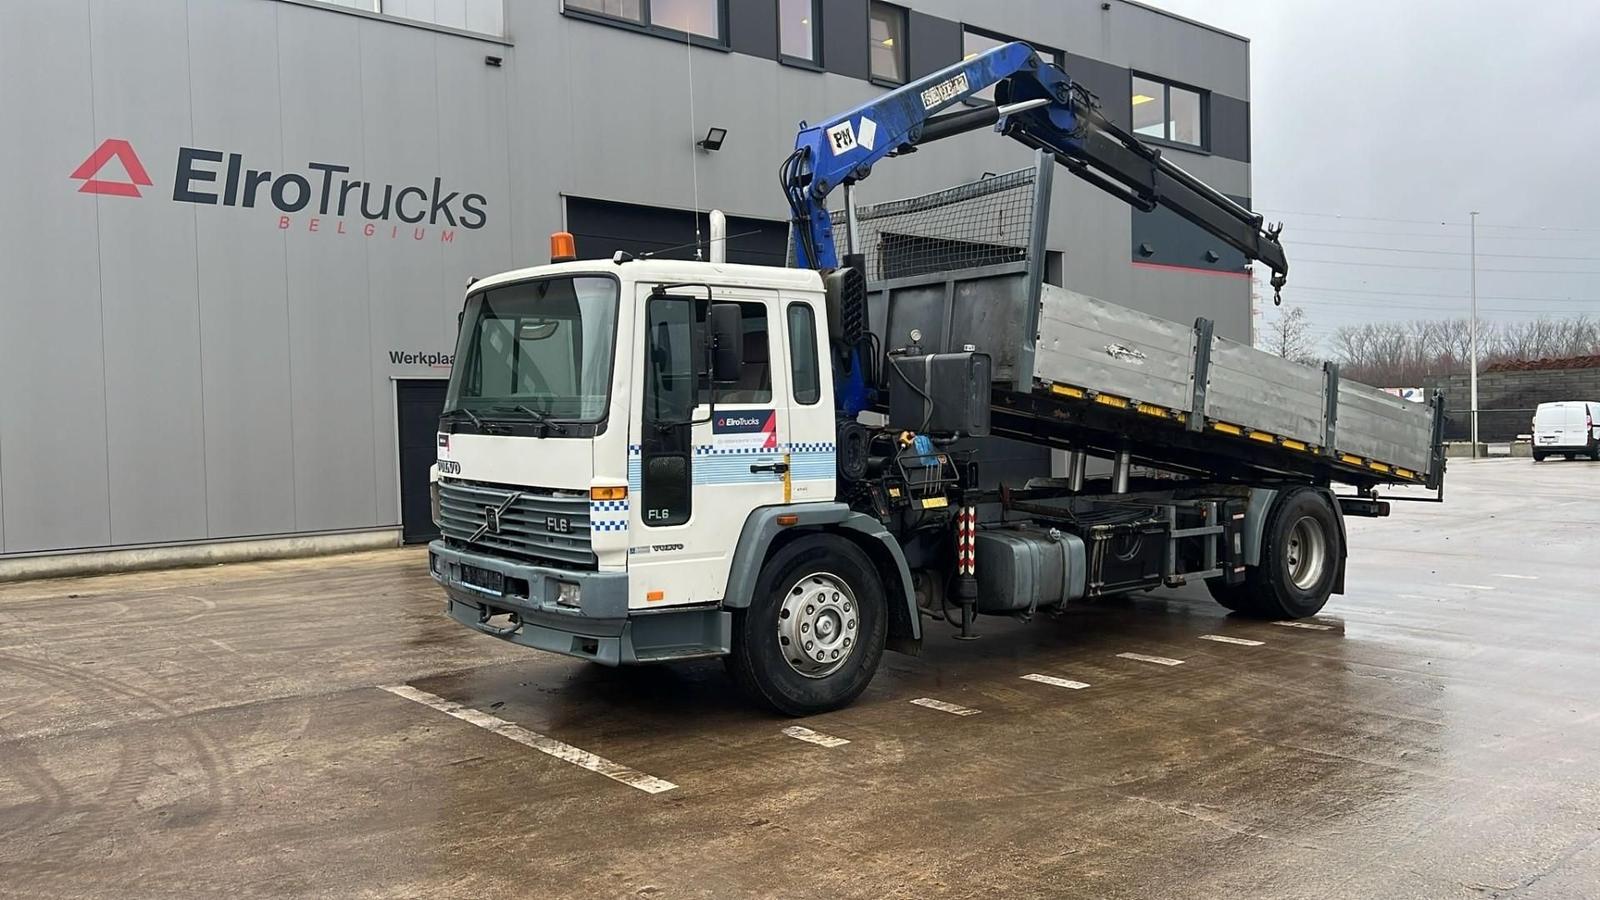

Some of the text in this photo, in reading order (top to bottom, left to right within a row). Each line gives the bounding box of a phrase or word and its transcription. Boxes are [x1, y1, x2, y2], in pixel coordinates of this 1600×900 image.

[833, 128, 853, 148] PM
[172, 147, 487, 229] ElroTrucks
[278, 215, 454, 242] BELGIUM
[726, 417, 760, 426] ElroTrucks
[648, 509, 669, 519] FL6
[547, 517, 567, 532] FL6
[652, 544, 684, 552] VOLVO
